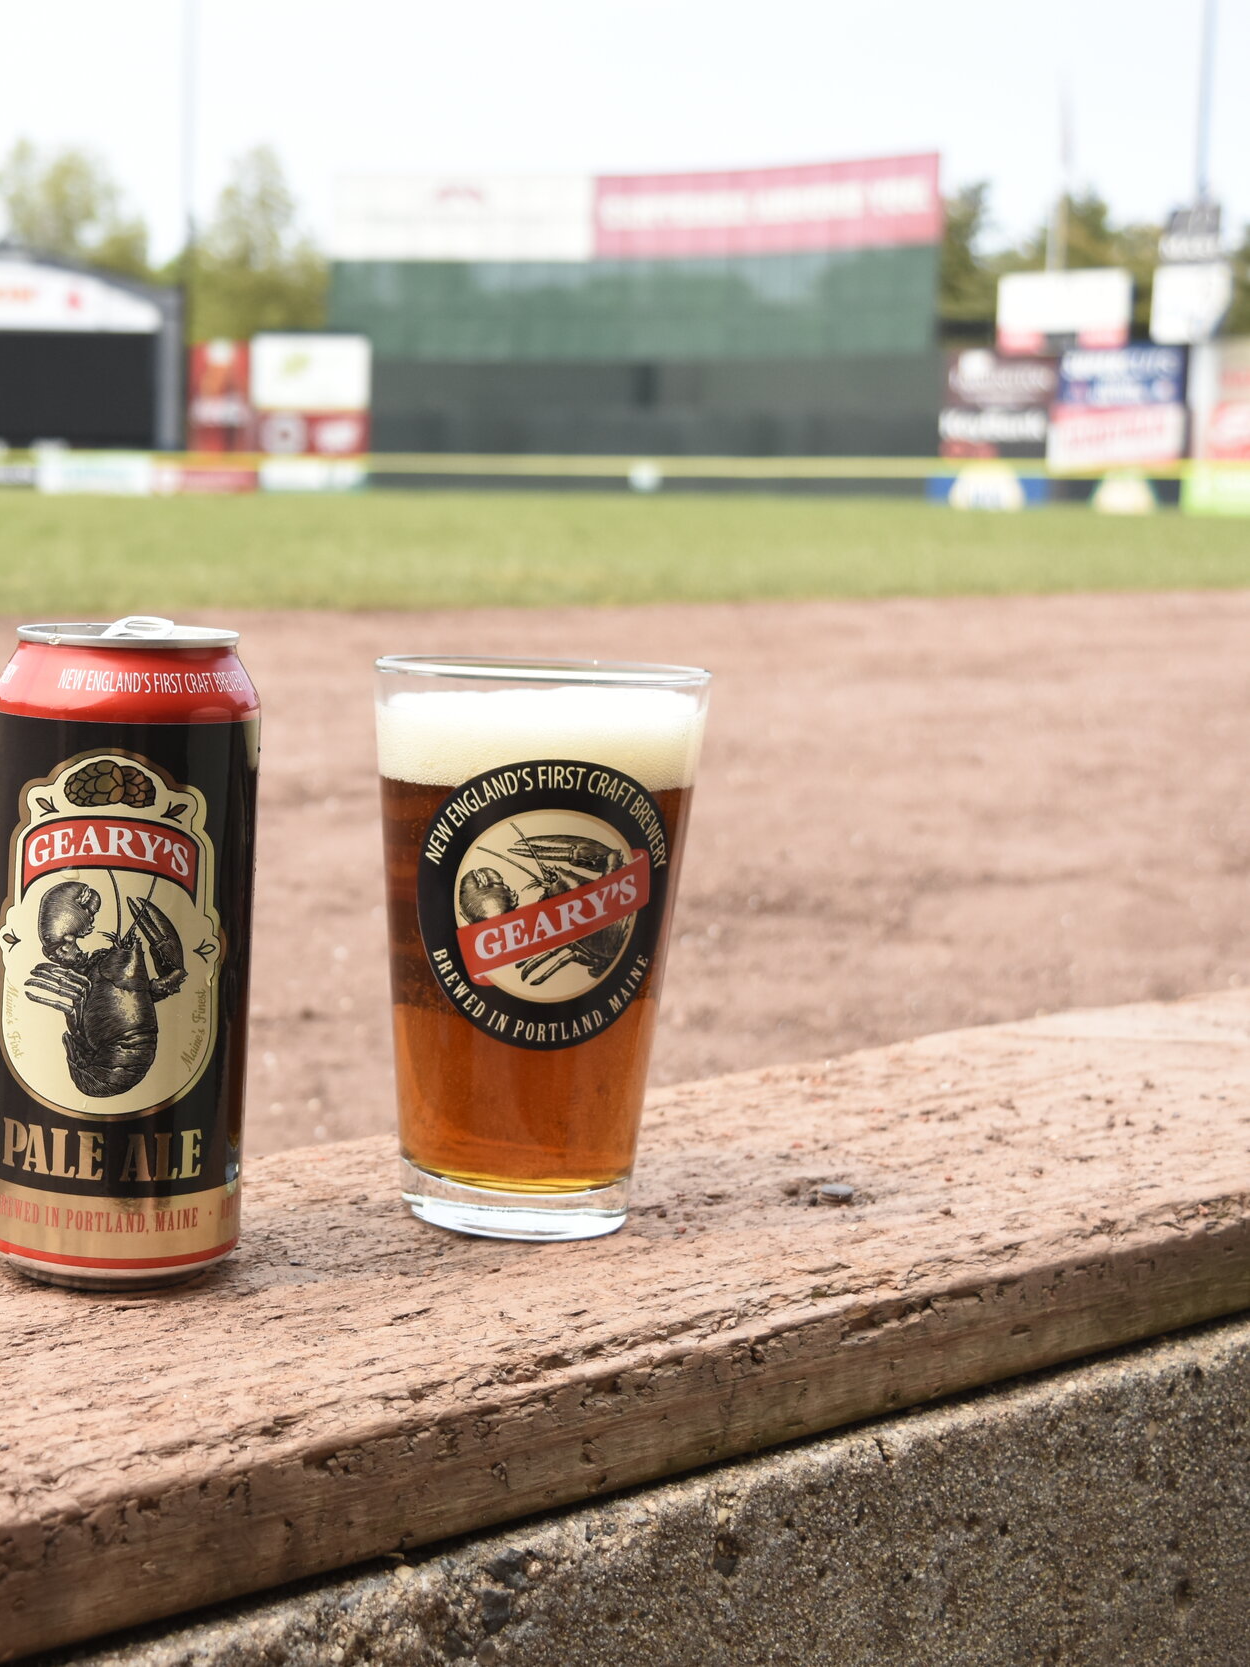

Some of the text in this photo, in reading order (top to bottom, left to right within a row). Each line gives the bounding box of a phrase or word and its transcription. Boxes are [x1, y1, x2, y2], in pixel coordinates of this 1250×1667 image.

[57, 668, 87, 690] NEW
[85, 670, 151, 693] ENGLAND'S
[154, 672, 184, 694] FIRST
[184, 672, 216, 694] CRAFT
[27, 825, 190, 877] GEARY'S
[425, 766, 668, 869] NEW ENGLAND'S FIRST CRAFT BREWERY
[474, 873, 637, 960] GEARY'S
[433, 947, 486, 1018] BREWED
[486, 1009, 510, 1033] IN
[608, 953, 649, 1014] MAINE
[180, 988, 207, 1072] Maine's Finest
[2, 1117, 203, 1181] PALE ALE
[45, 1205, 60, 1228] IN
[65, 1208, 149, 1236] PORTLAND,
[155, 1207, 199, 1233] MAINE
